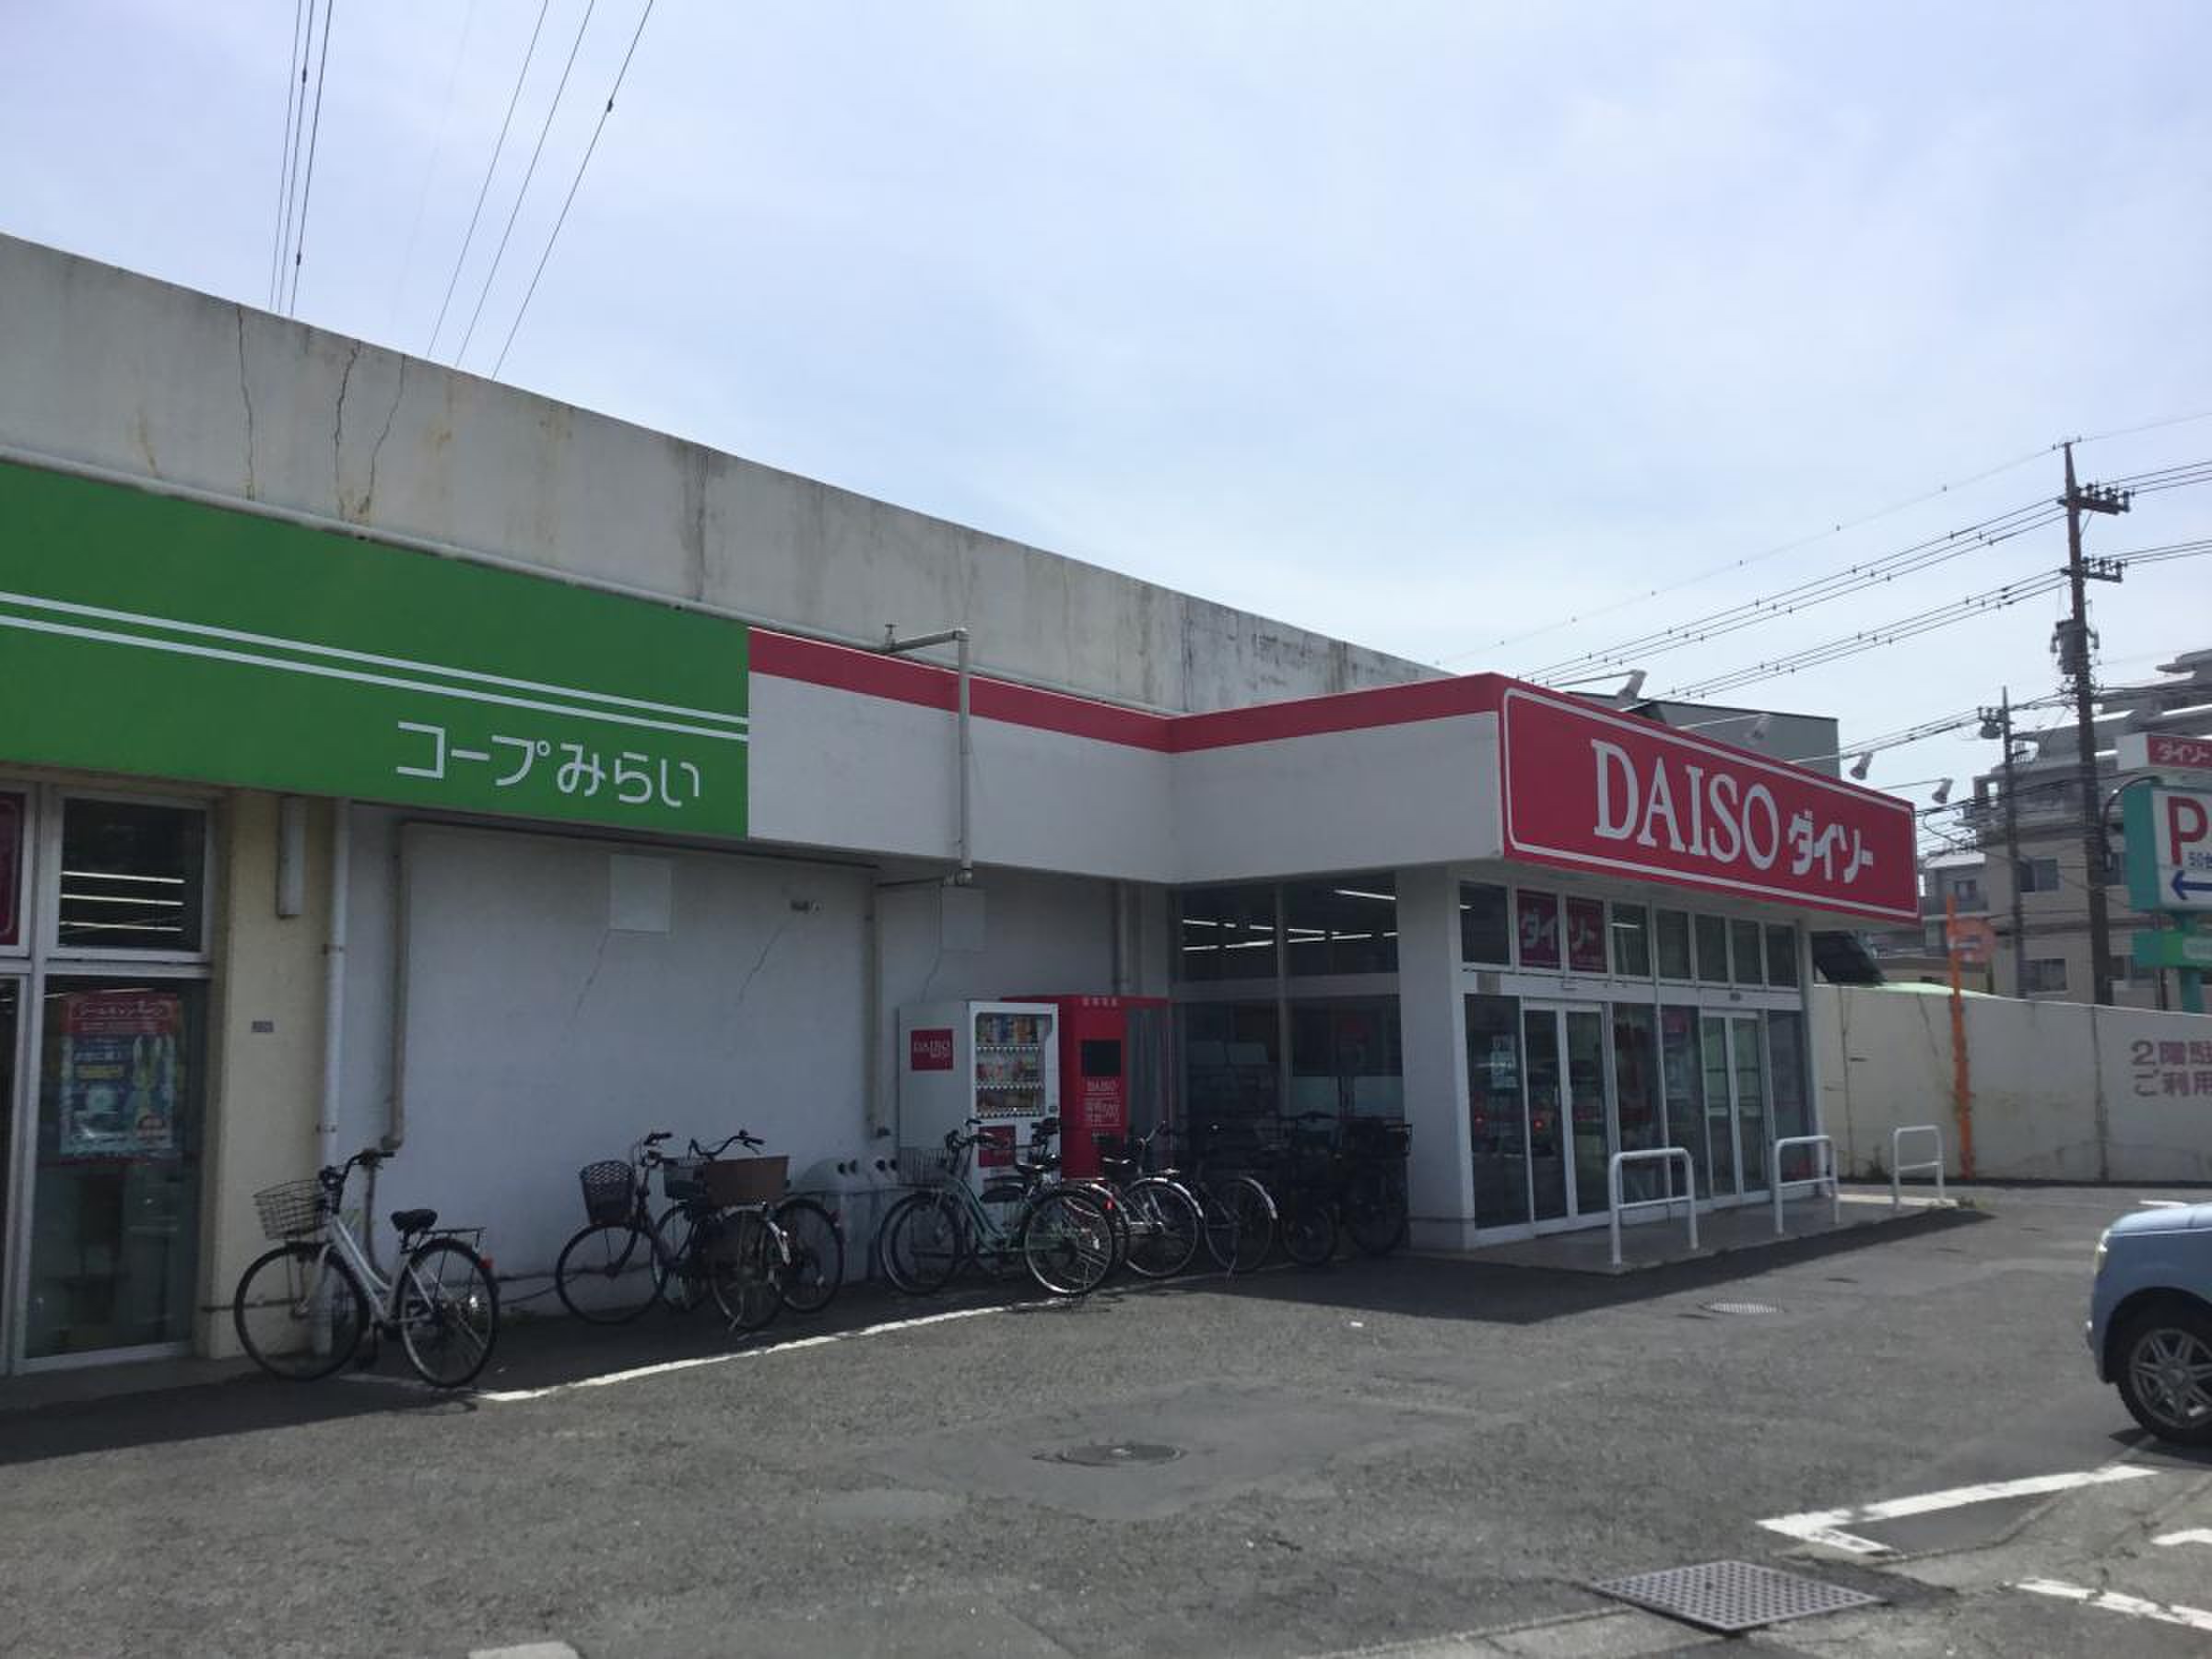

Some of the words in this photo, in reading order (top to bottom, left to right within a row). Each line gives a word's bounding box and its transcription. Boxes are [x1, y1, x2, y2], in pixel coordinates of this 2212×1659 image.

[396, 721, 699, 807] コープみらい
[1591, 739, 1780, 870] DAISO
[1788, 809, 1873, 884] ダイソー
[2168, 795, 2208, 865] P
